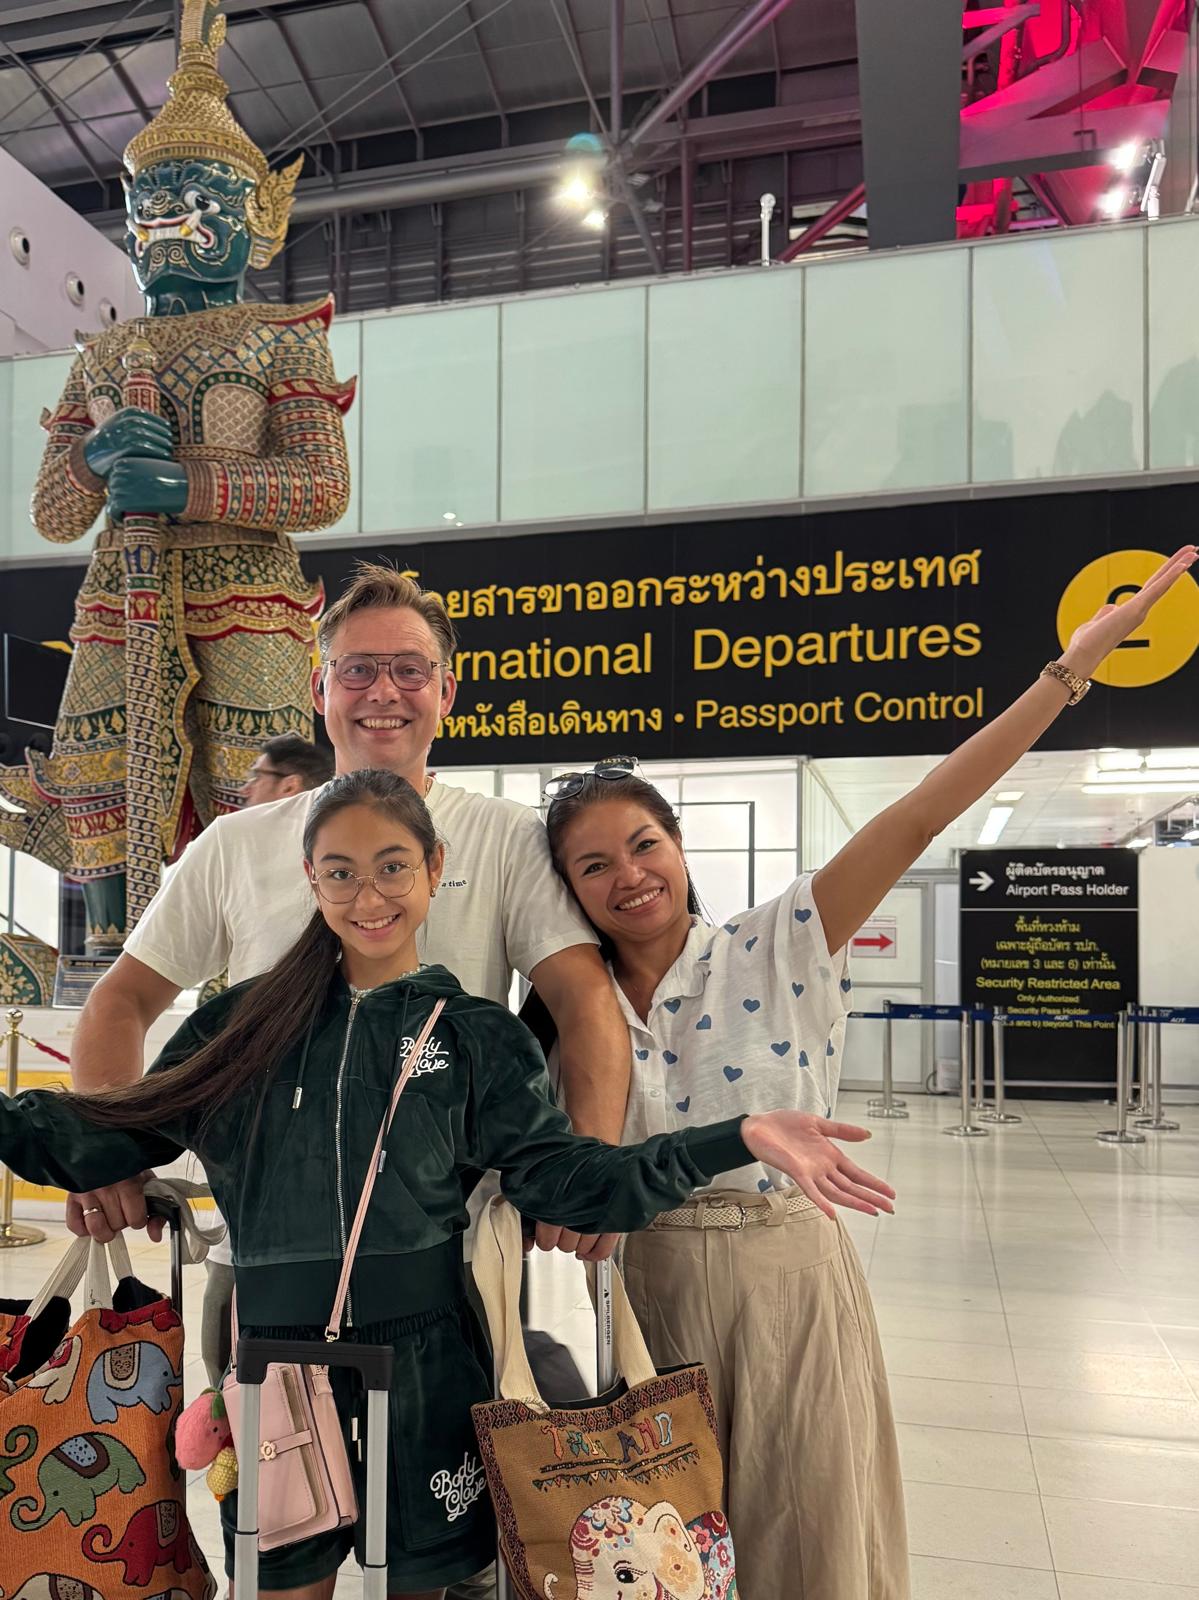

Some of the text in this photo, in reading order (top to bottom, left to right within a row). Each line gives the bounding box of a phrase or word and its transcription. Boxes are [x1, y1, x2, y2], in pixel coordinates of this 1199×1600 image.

[400, 549, 982, 619] ยสารขาออกระหว่างประเทศ
[449, 622, 984, 682] rnational Departures
[434, 687, 983, 739] หนังสือเดินทาง Passport Control
[448, 879, 467, 888] time
[1005, 883, 1129, 898] Airport Pass Holder
[1033, 958, 1040, 969] 3
[976, 976, 1121, 990] Security Restricted Area
[1040, 1006, 1061, 1015] Pass
[1062, 1007, 1090, 1015] Holder
[399, 1036, 450, 1059] Bdy
[429, 1451, 484, 1499] Body
[445, 1476, 487, 1522] Glove
